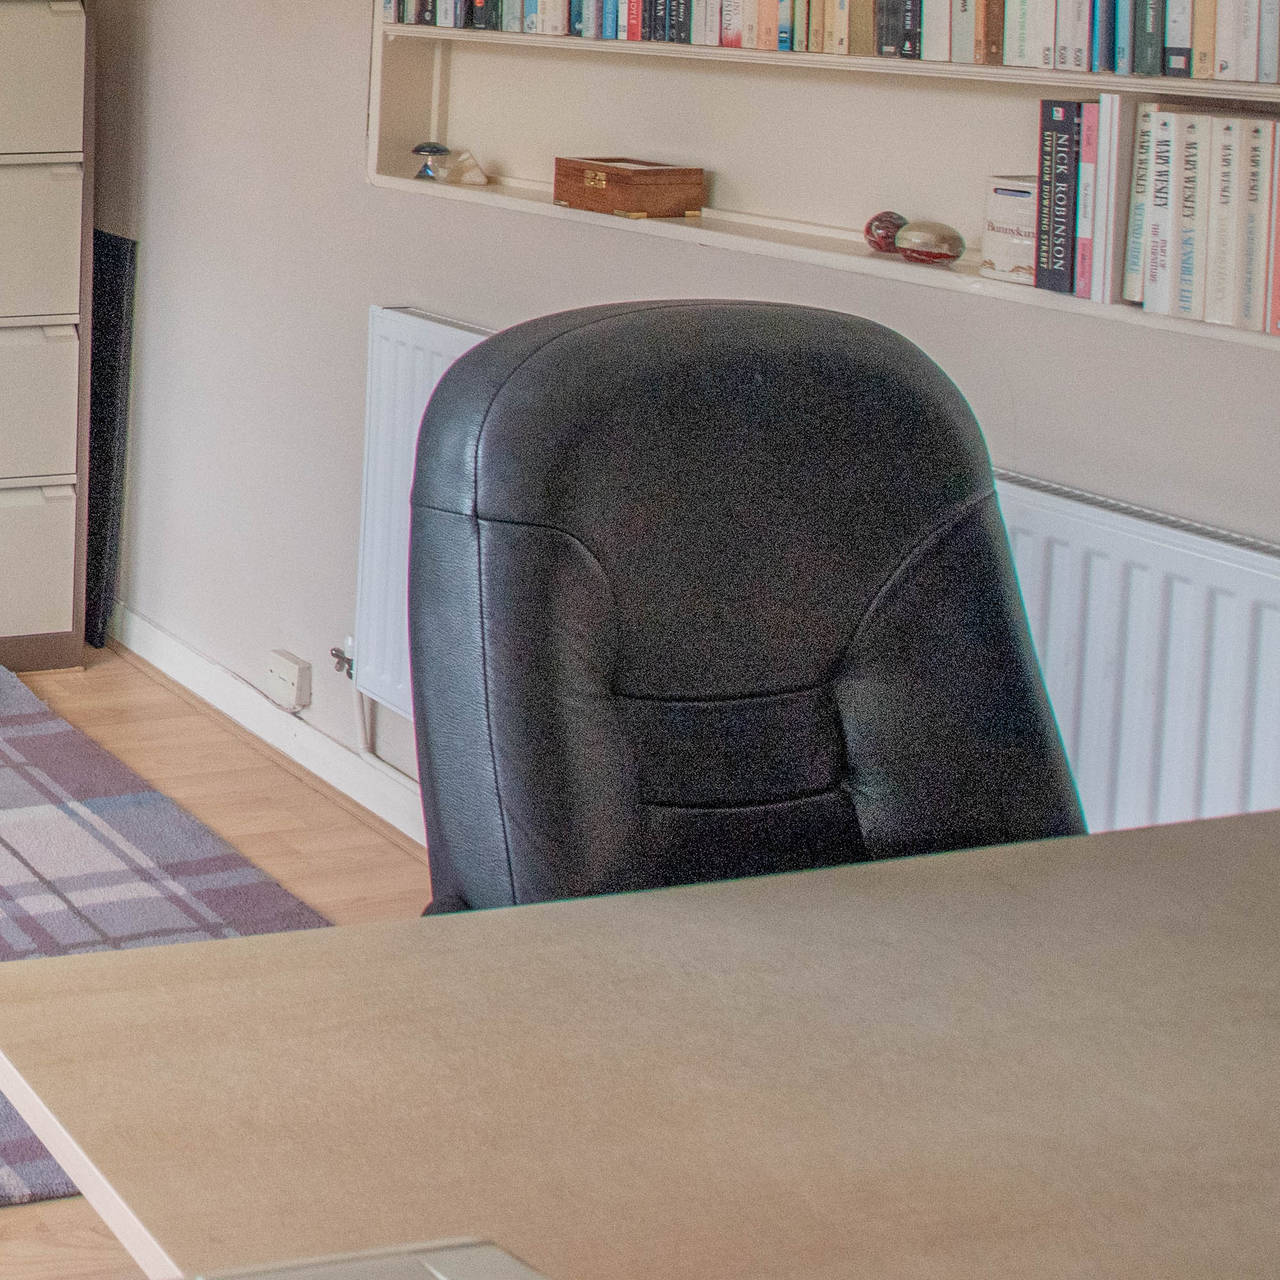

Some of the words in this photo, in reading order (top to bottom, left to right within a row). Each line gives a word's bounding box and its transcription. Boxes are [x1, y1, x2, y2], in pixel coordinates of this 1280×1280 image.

[657, 0, 665, 16] VAN
[1043, 131, 1052, 152] LIVE
[1055, 134, 1070, 174] NICK
[1138, 129, 1151, 162] MARY
[1155, 139, 1171, 168] MARY
[1221, 145, 1232, 168] MARY
[1249, 146, 1261, 168] MARY
[1042, 155, 1051, 182] FROM
[1183, 142, 1198, 175] MARY
[1135, 165, 1148, 195] WESLEY
[1153, 170, 1169, 209] WESLEY
[1219, 171, 1231, 206] WESLEY
[1248, 171, 1259, 203] WESLEY
[1041, 185, 1051, 232] DOWNING
[1182, 176, 1196, 221] WESLEY
[1052, 182, 1069, 271] ROBINSON
[1131, 203, 1145, 239] SECOND
[1151, 223, 1159, 237] THE
[1040, 234, 1049, 269] STREET
[1128, 241, 1142, 276] FIDDLE
[1180, 236, 1195, 284] SENSIBLE
